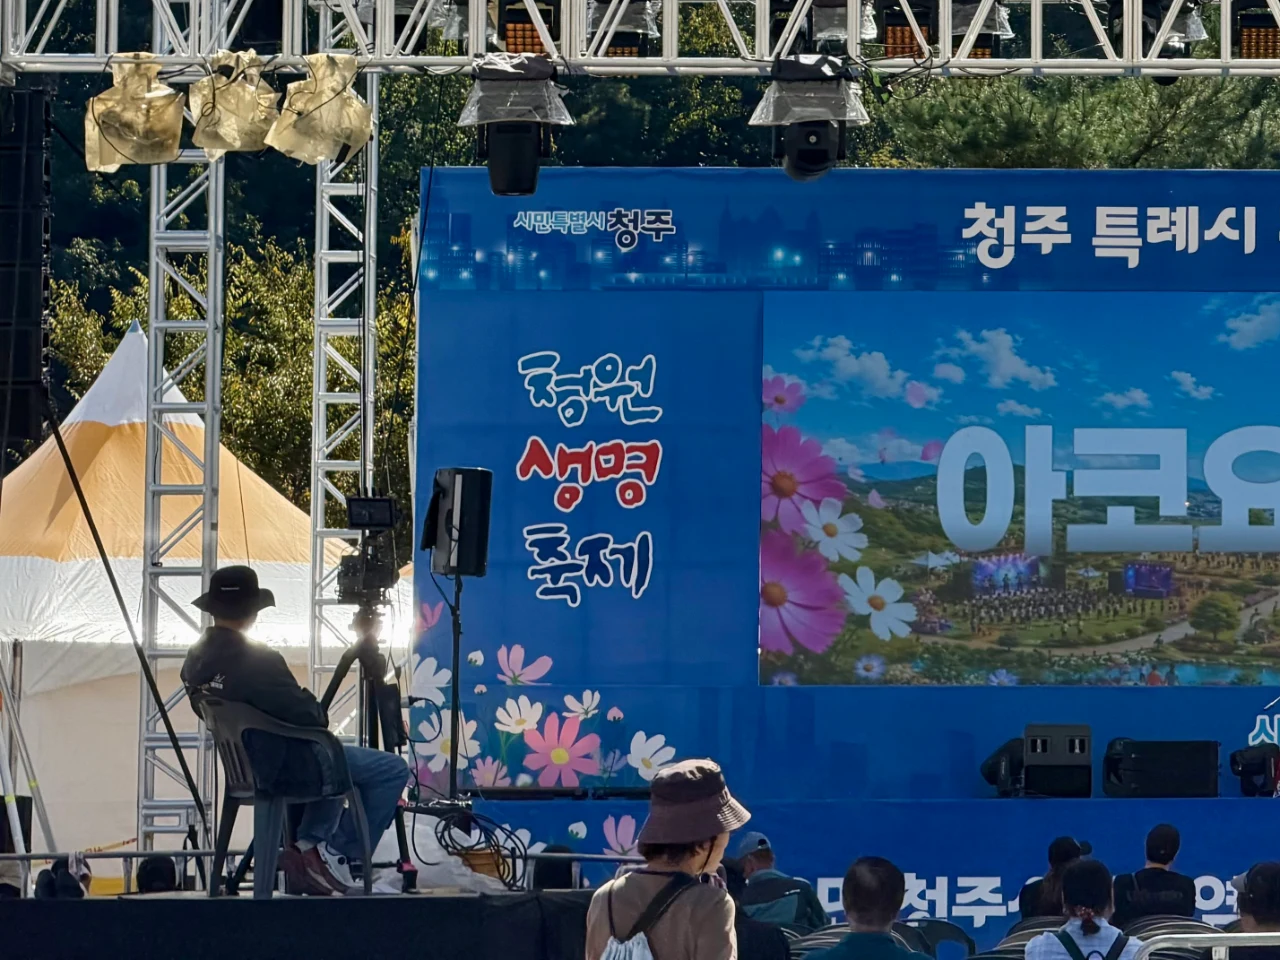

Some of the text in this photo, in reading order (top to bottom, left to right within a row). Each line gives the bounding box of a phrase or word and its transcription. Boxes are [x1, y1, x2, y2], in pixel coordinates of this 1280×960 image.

[606, 208, 676, 253] 청주
[962, 202, 1071, 269] 청주
[1092, 206, 1256, 268] 특례시
[517, 350, 663, 428] 청원
[516, 435, 663, 513] 생명
[523, 522, 654, 608] 축제
